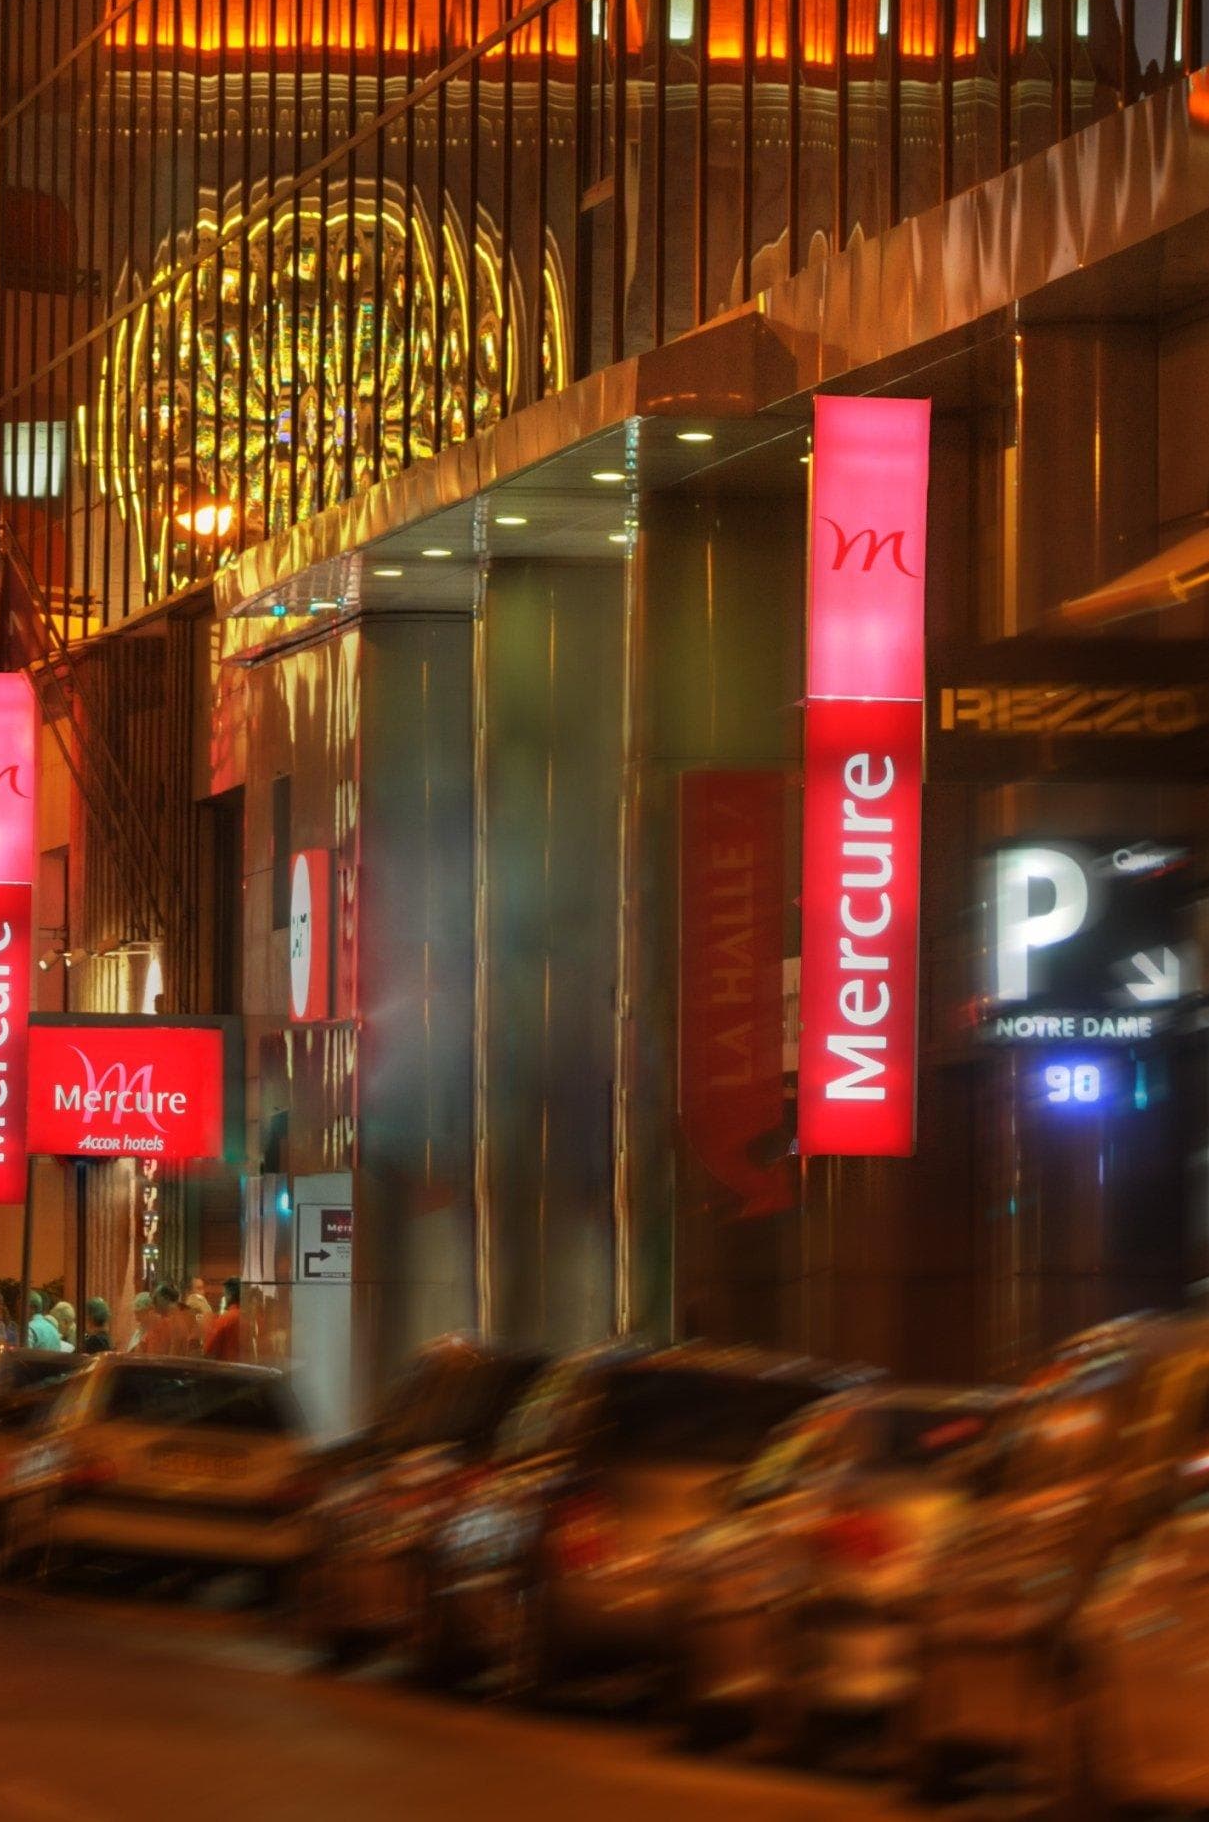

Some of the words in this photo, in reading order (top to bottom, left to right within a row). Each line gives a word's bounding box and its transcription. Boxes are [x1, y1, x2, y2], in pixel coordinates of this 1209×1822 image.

[940, 688, 1195, 732] REZZO
[712, 842, 753, 1004] HALLE
[826, 752, 893, 1101] Mercure
[997, 848, 1088, 1000] P
[996, 1016, 1074, 1038] NOTRE
[1083, 1016, 1152, 1038] DAME
[54, 1084, 186, 1114] Mercure
[123, 1134, 164, 1151] hotels
